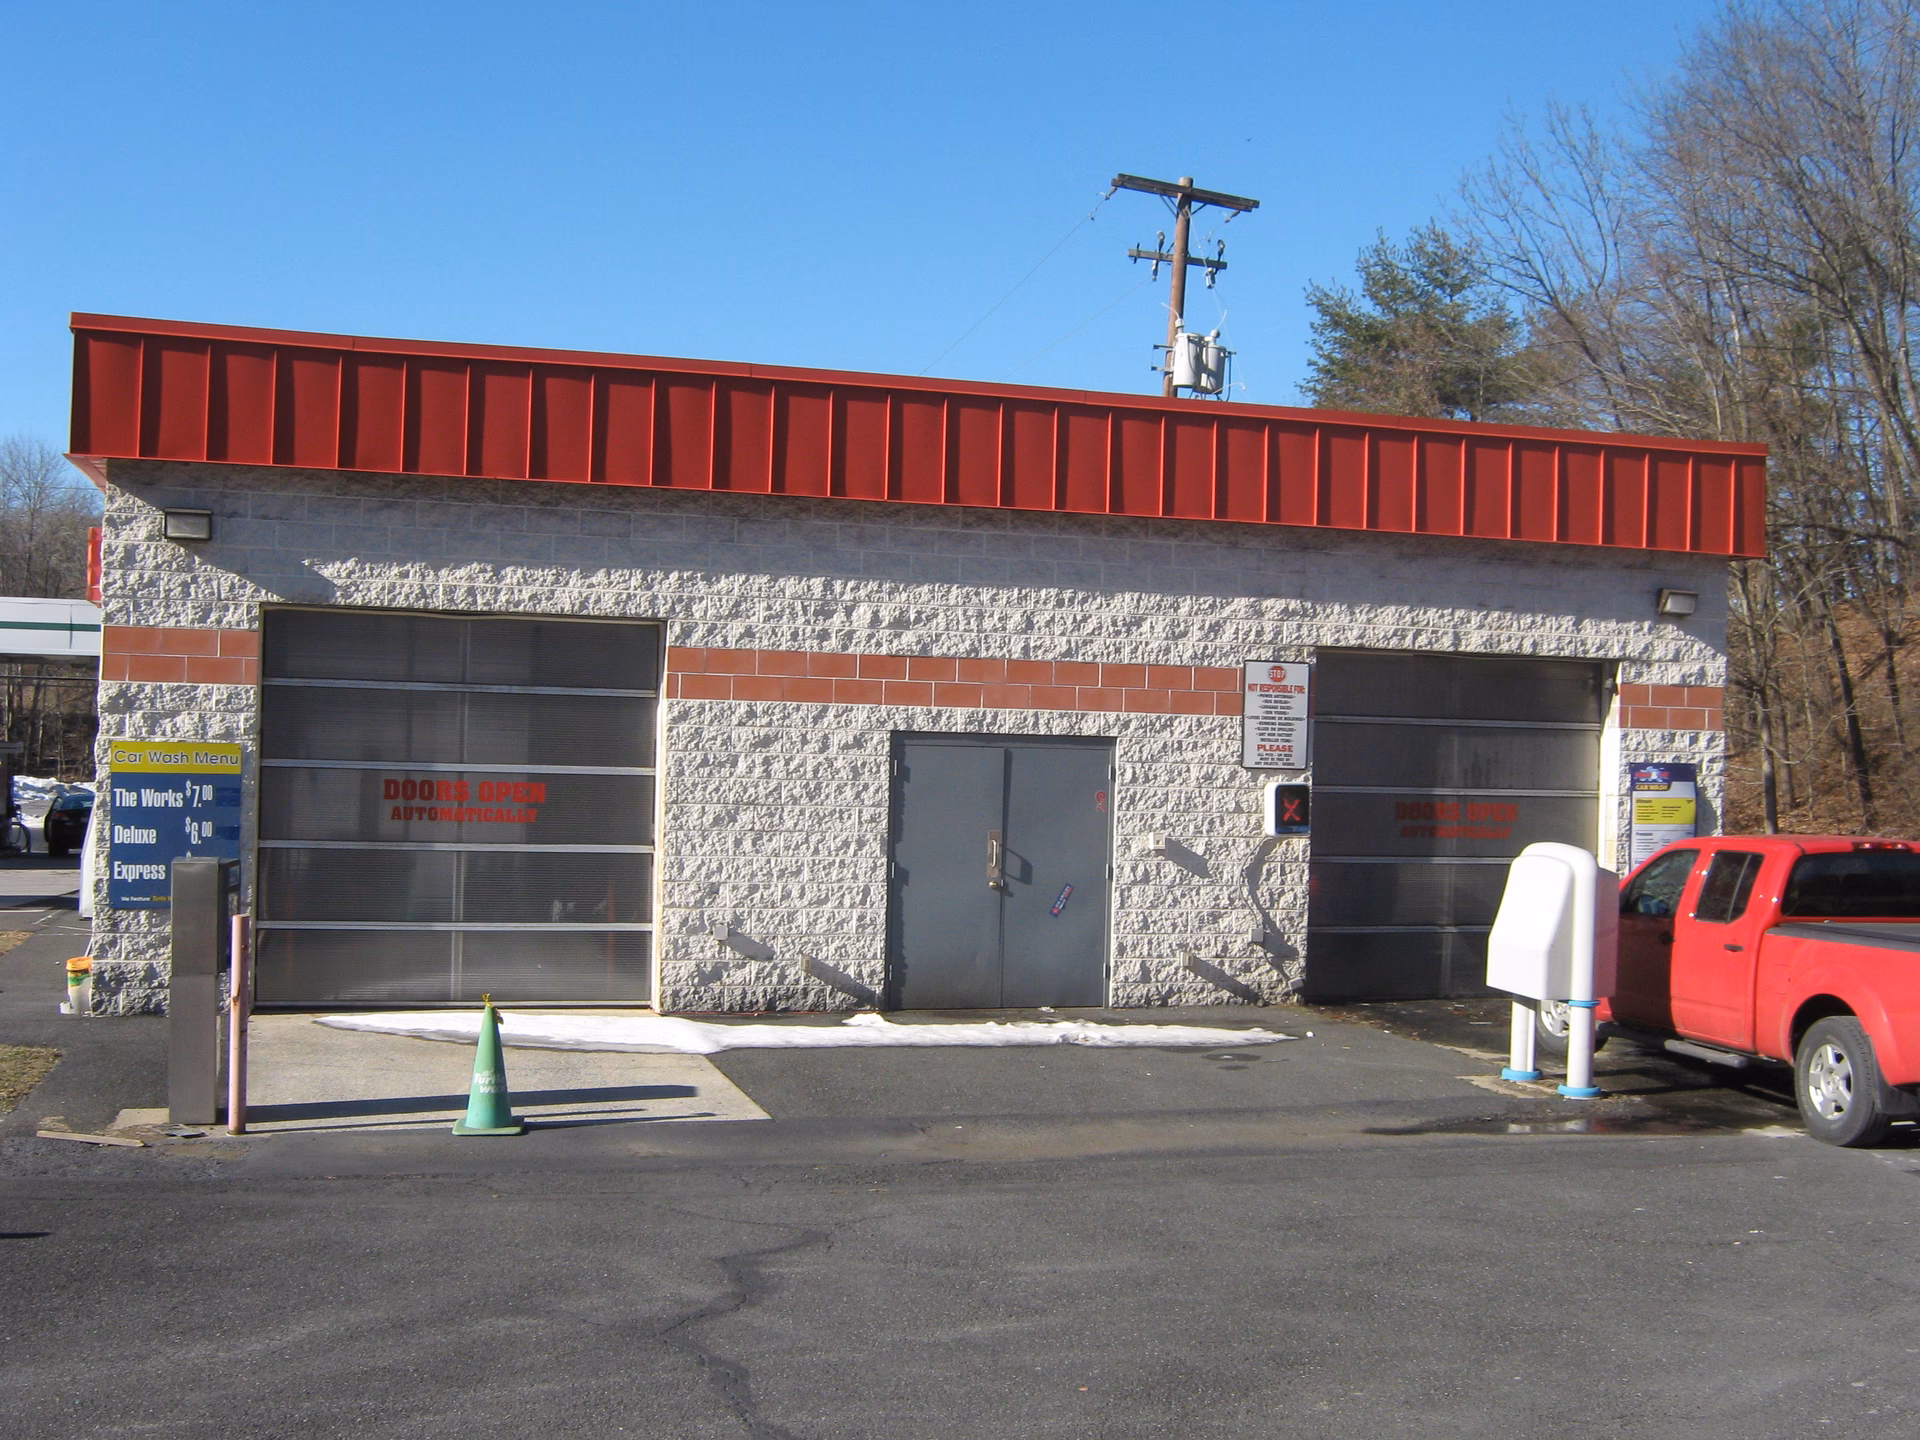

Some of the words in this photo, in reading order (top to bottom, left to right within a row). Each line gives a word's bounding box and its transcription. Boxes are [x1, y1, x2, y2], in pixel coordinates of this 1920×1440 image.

[1269, 669, 1286, 679] STOP
[1257, 744, 1294, 752] PLEASE
[114, 750, 143, 763] Car
[148, 751, 189, 764] Wash
[194, 751, 239, 765] Menu
[113, 788, 138, 808] The
[141, 788, 184, 808] Works
[185, 779, 213, 808] $7.00
[383, 779, 470, 803] DOORS
[478, 781, 546, 803] OPEN
[391, 806, 539, 822] AUTOMATICALLY
[114, 825, 157, 844] Deluxe
[185, 816, 213, 845] $6.00
[113, 861, 166, 882] Express
